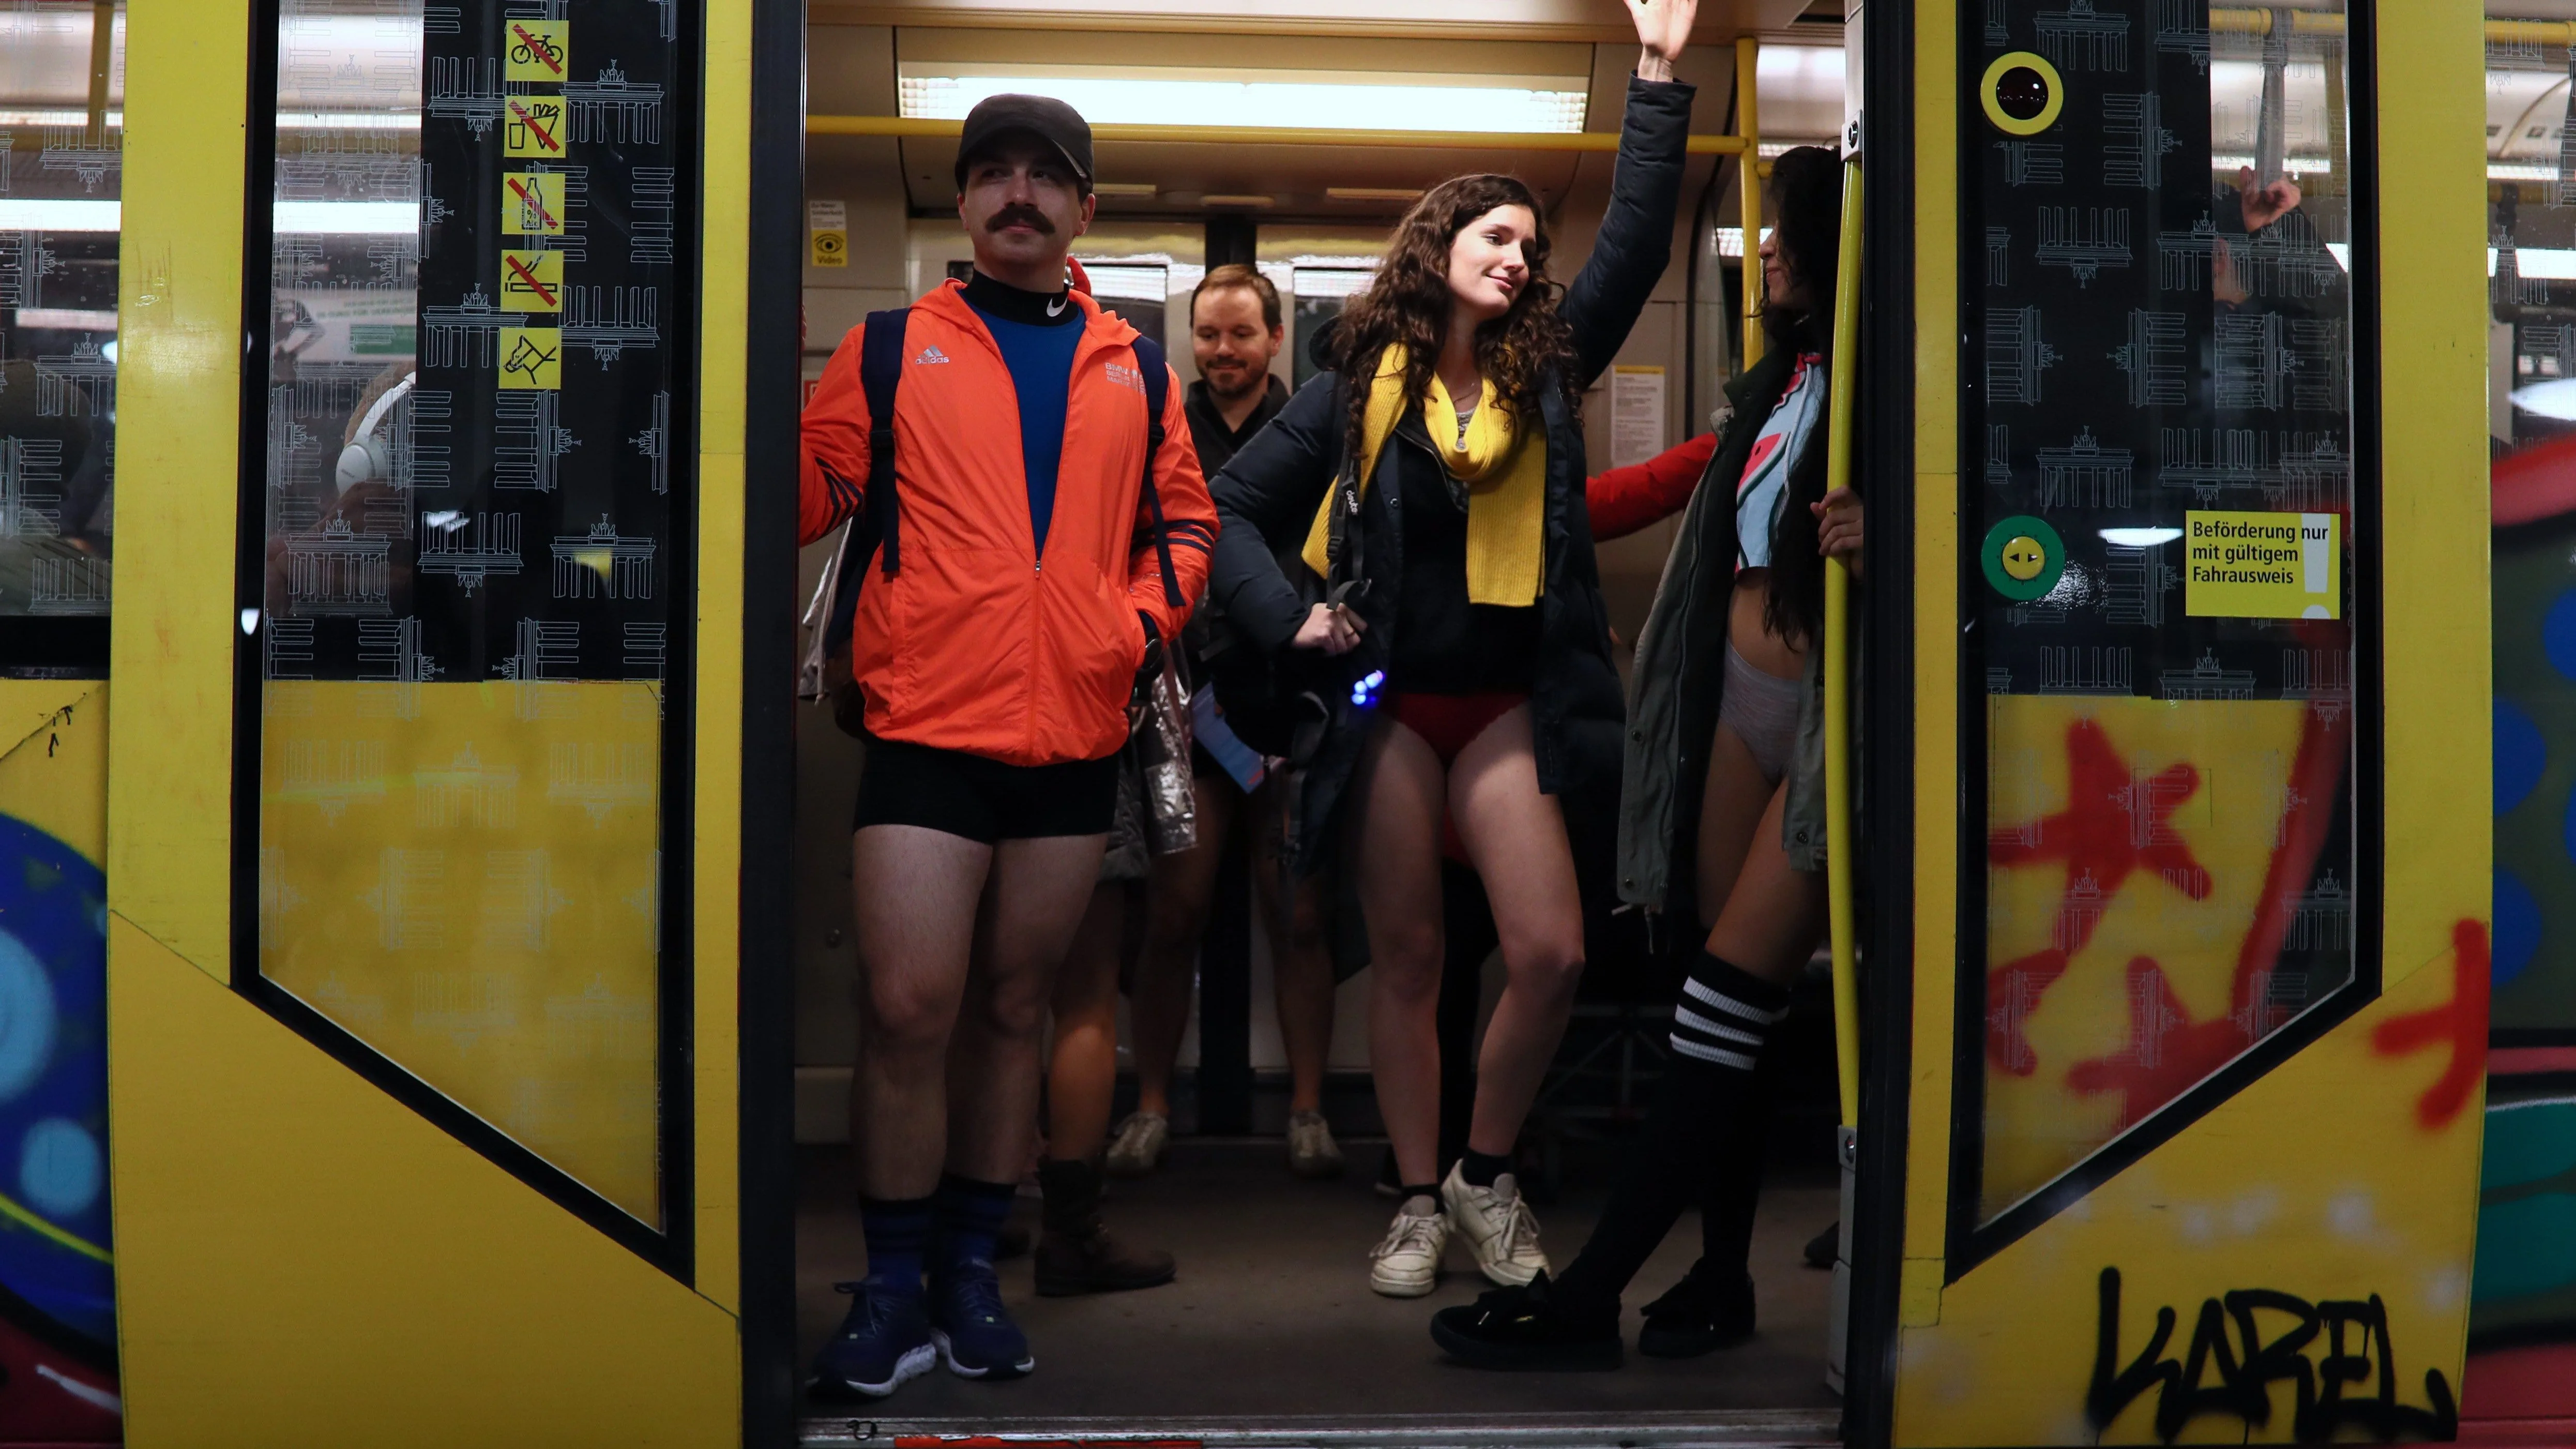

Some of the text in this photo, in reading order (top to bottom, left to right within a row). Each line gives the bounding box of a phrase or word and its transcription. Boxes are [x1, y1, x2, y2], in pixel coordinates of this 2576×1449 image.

[915, 356, 949, 364] adidas
[1105, 362, 1128, 374] BMW
[2193, 521, 2328, 543] Beförderung nur
[2193, 544, 2298, 565] mit gültigem
[2193, 566, 2294, 584] Fahrausweis
[2086, 1266, 2458, 1446] KAREL
